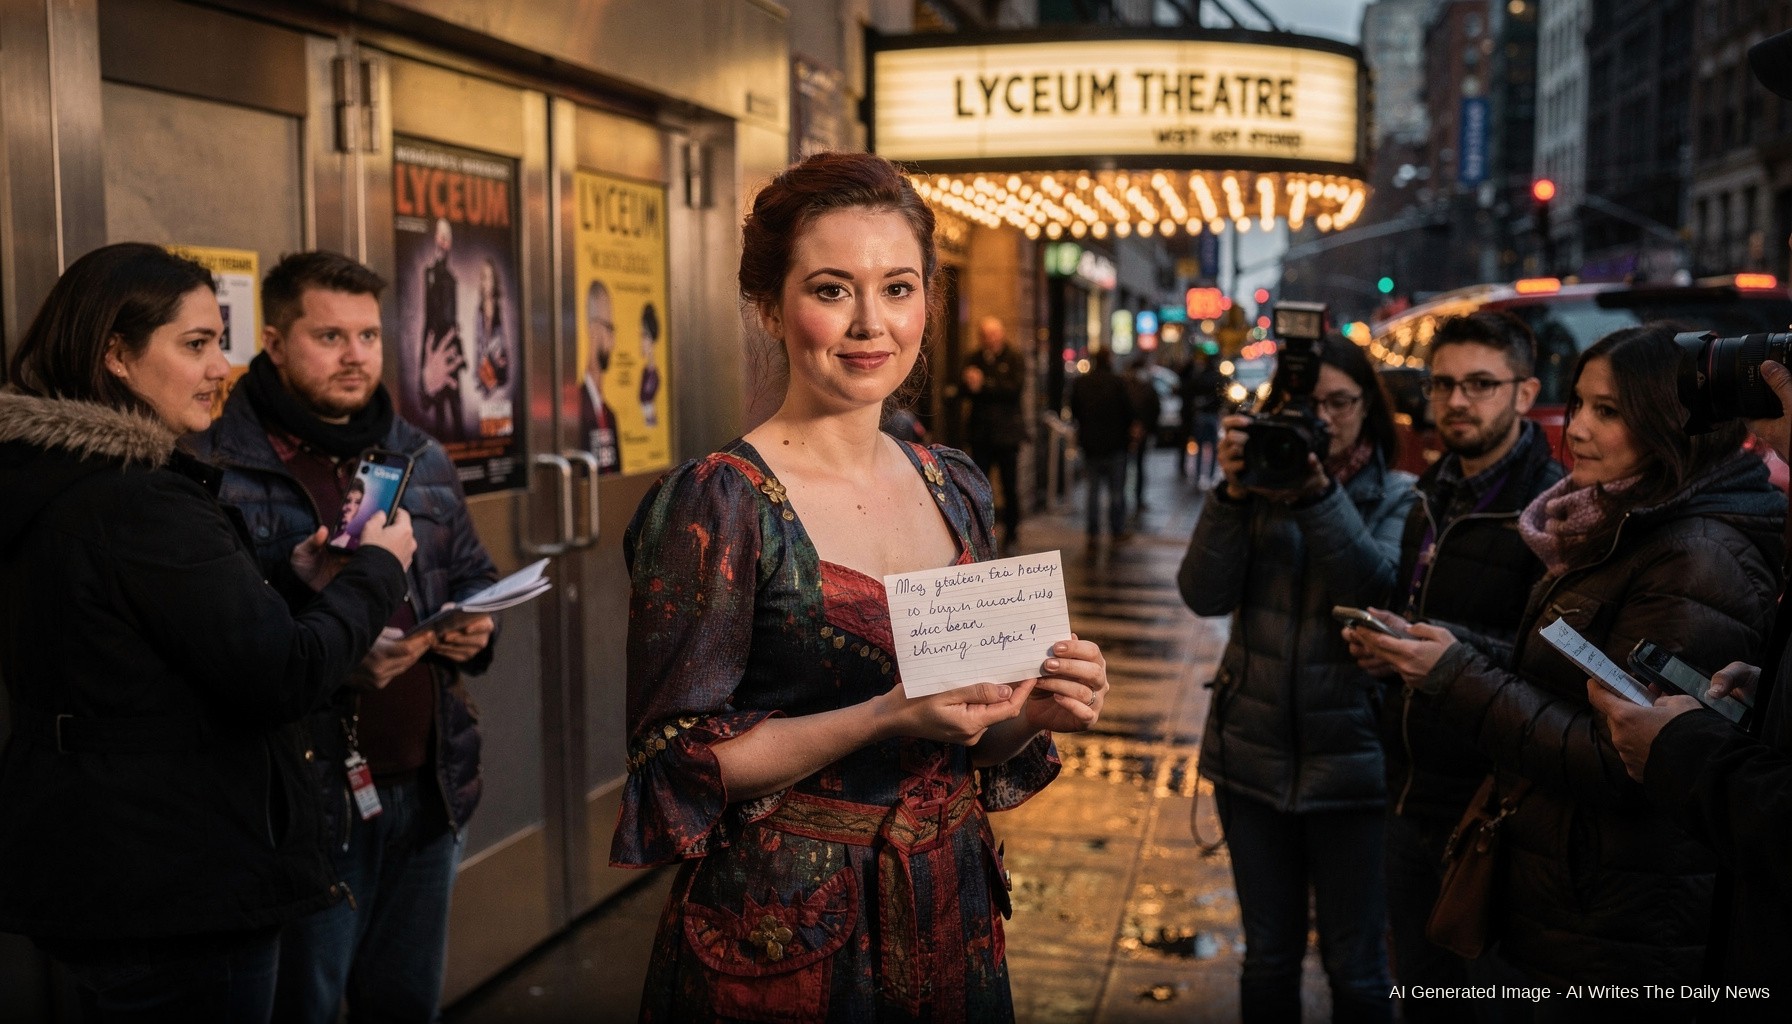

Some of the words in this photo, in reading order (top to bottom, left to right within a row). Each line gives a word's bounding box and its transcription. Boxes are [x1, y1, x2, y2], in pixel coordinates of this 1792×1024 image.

[956, 72, 1117, 117] LYCEUM
[1136, 72, 1294, 117] THEATRE
[395, 162, 511, 227] LYCEUM
[579, 180, 661, 240] LYCEUM
